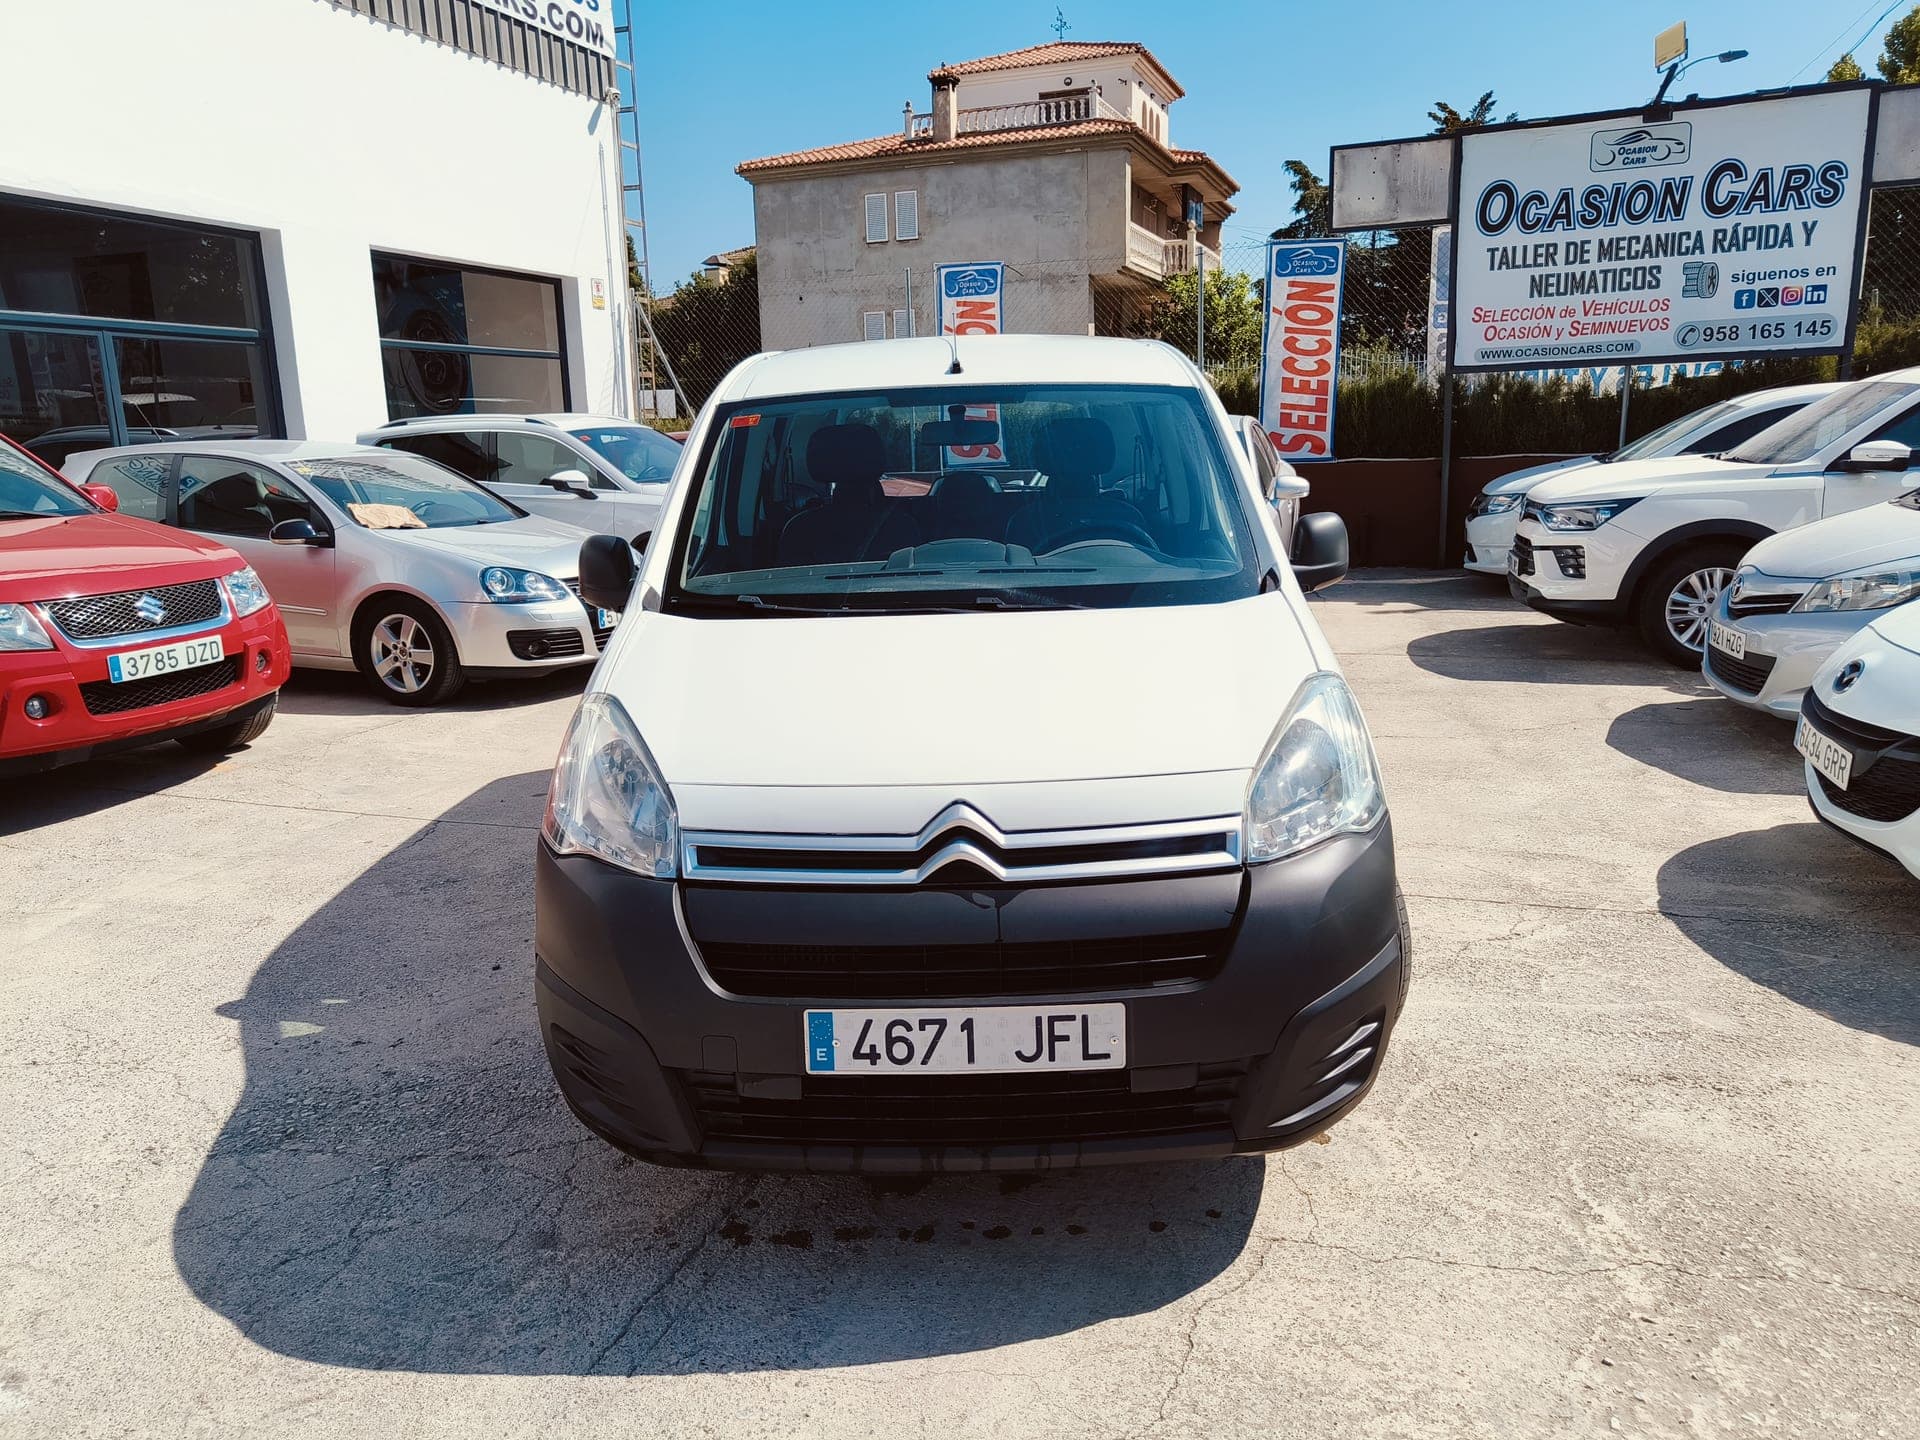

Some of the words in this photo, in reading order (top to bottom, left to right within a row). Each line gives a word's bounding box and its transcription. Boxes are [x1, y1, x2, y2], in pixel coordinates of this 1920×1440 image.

[1618, 145, 1658, 156] OCASION
[1622, 157, 1647, 166] CARS
[1476, 176, 1694, 237] OCASION
[1701, 158, 1848, 218] CARS
[1487, 242, 1558, 271] TALLER
[1564, 240, 1592, 266] DE
[1599, 230, 1705, 263] MECANICA
[1712, 222, 1794, 254] RÁPIDA
[1802, 220, 1818, 247] Y
[1529, 265, 1662, 299] NEUMATICOS
[1731, 267, 1810, 285] siguenos
[1815, 265, 1837, 277] en
[1472, 304, 1555, 324] SELECCIÓN
[1559, 305, 1576, 319] de
[1582, 298, 1671, 317] VEHÍCULOS
[1484, 323, 1553, 342] OCASIÓN
[1555, 326, 1564, 341] y
[1568, 317, 1671, 337] SEMINUEVOS
[1702, 325, 1740, 342] 958
[1748, 322, 1786, 340] 165
[1794, 319, 1832, 337] 145
[1480, 343, 1635, 360] WWW.OCASIONCARS.COM
[1269, 280, 1336, 456] SELECCIÓN
[1726, 631, 1742, 654] HZG
[126, 649, 179, 677] 3785
[185, 640, 221, 665] DZD
[1800, 722, 1822, 763] 6434
[1824, 744, 1847, 784] GRR
[852, 1018, 975, 1066] 4671
[1014, 1014, 1111, 1063] JFL
[816, 1048, 827, 1061] E
